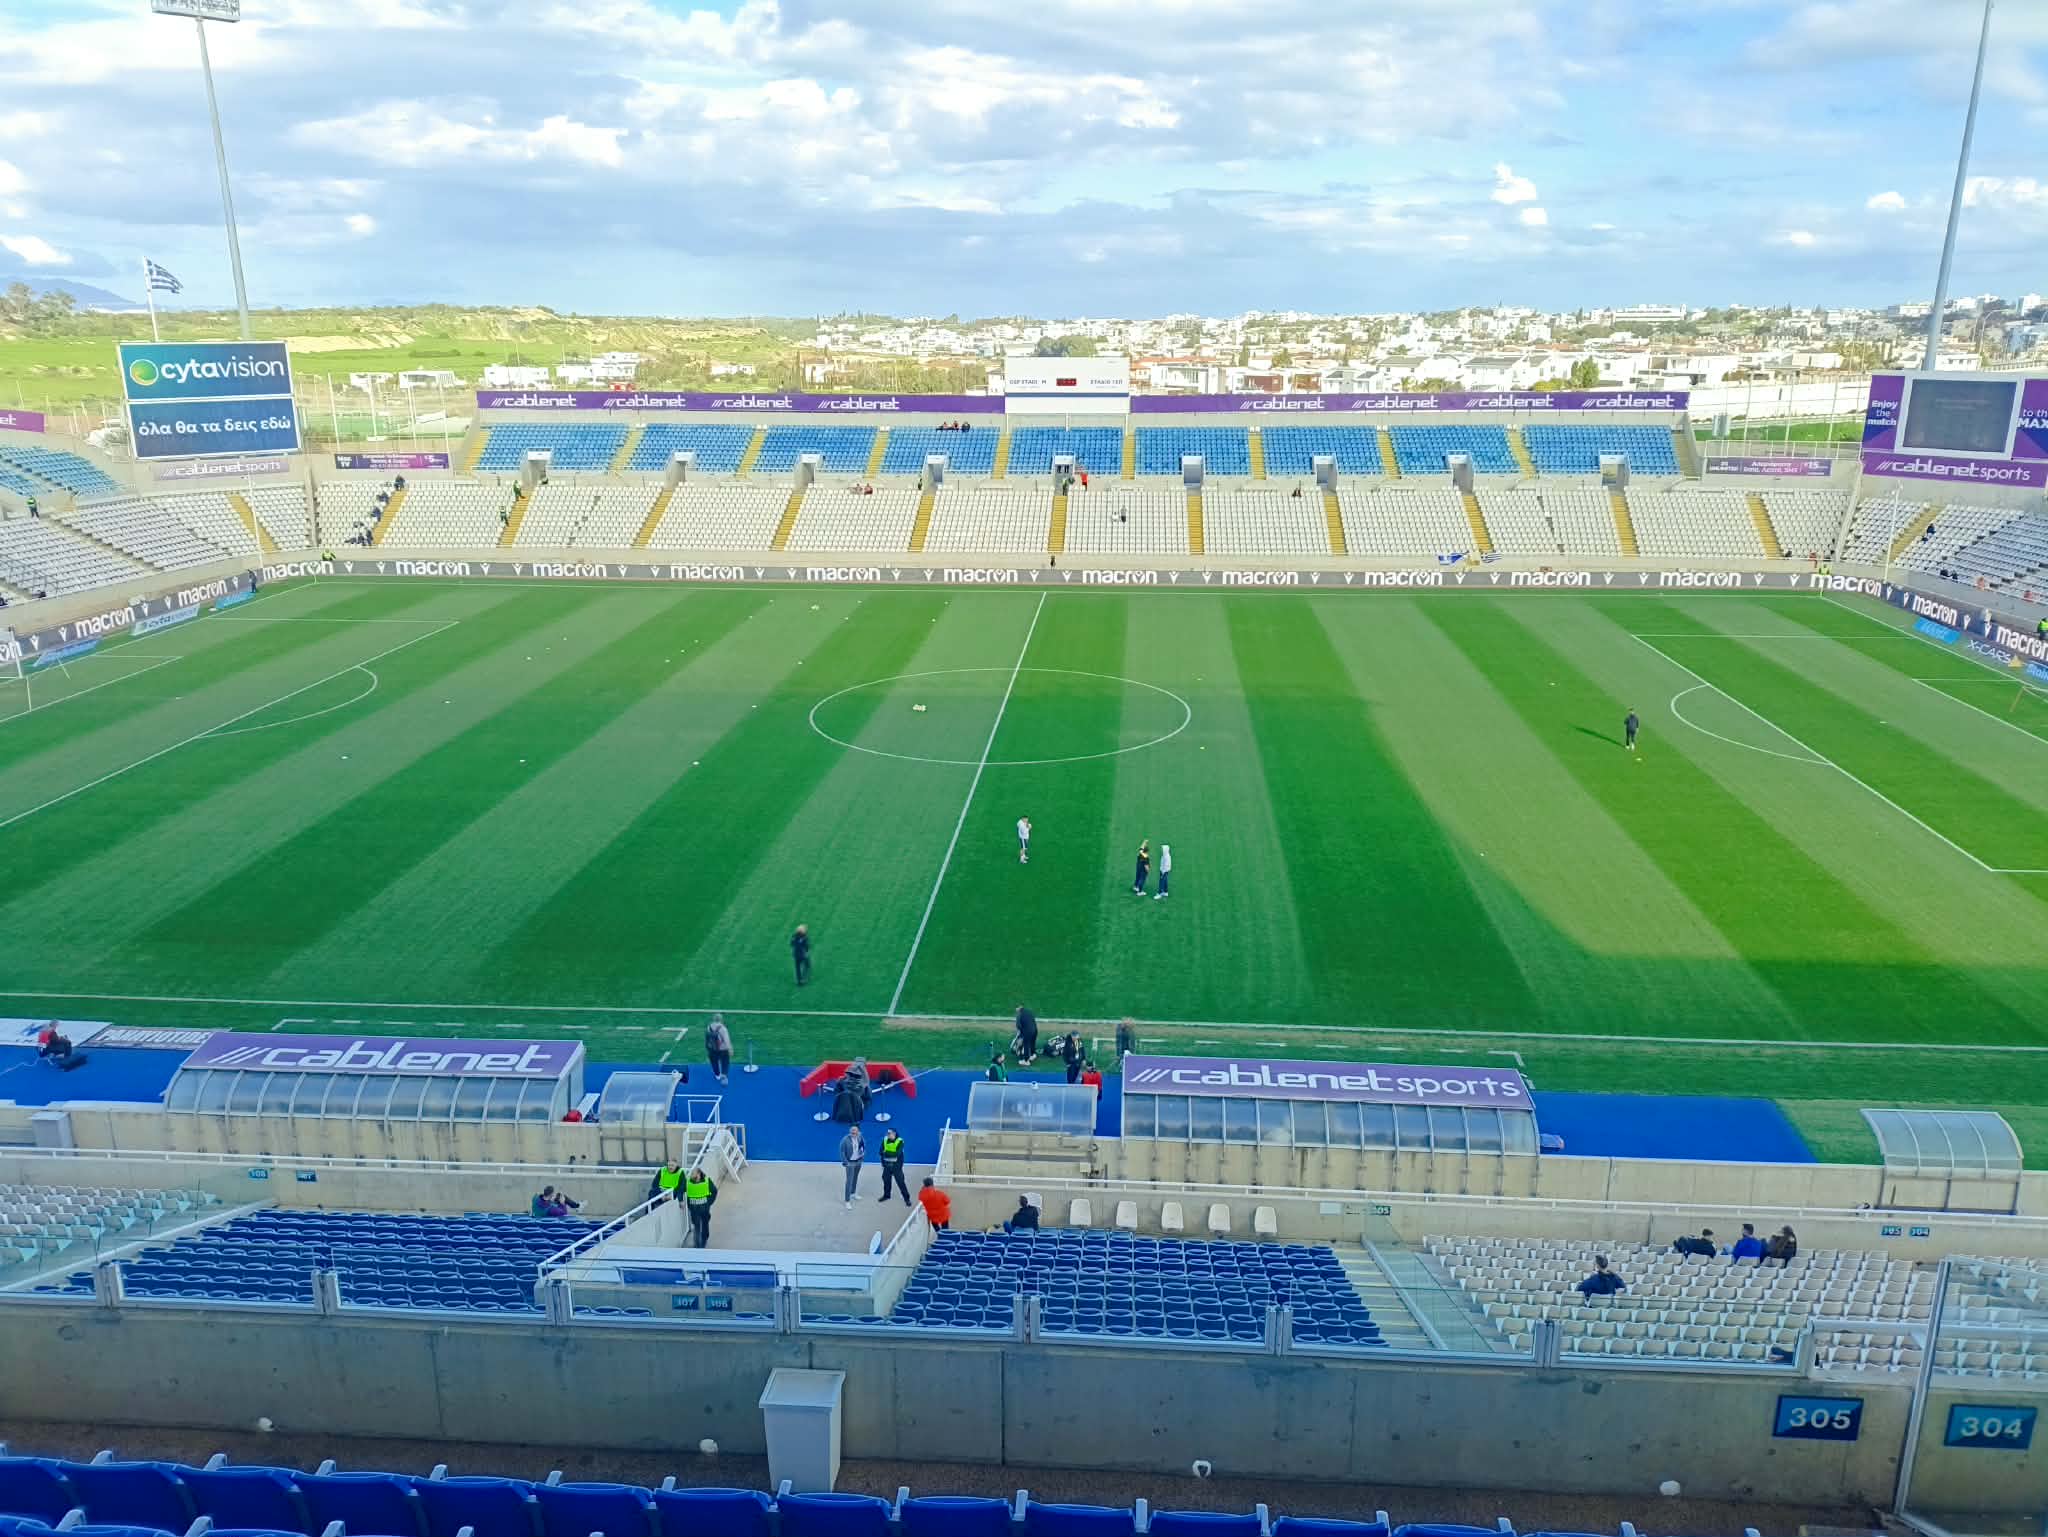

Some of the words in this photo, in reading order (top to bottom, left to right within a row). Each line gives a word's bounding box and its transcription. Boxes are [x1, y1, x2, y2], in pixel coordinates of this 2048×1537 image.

[161, 355, 284, 383] cytavision
[503, 394, 577, 407] cablenet
[614, 394, 687, 408] cablenet
[723, 395, 793, 409] cablenet
[831, 397, 900, 410] cablenet
[1250, 396, 1325, 410] cablenet
[1363, 395, 1438, 409] cablenet
[1477, 394, 1554, 408] cablenet
[1593, 394, 1675, 408] cablenet
[1872, 400, 1898, 410] Enjoy
[1876, 409, 1891, 417] the
[2023, 409, 2034, 417] to
[139, 420, 172, 436] όλα
[175, 421, 198, 434] θα
[201, 423, 221, 433] τα
[224, 419, 258, 432] δεις
[261, 415, 291, 430] εδώ
[1867, 418, 1897, 426] match
[262, 560, 334, 581] macron
[396, 561, 470, 576] macron
[532, 563, 607, 577] macron
[670, 565, 744, 579] macron
[806, 566, 881, 581] macron
[943, 568, 1018, 582] macron
[1082, 569, 1158, 584] macron
[1222, 570, 1299, 584] macron
[1364, 571, 1443, 586] macron
[1510, 571, 1591, 586] macron
[1660, 572, 1742, 587] macron
[178, 579, 228, 607] macron
[1810, 574, 1882, 598] macron
[1912, 595, 1958, 626] macron
[75, 606, 136, 638] macron
[260, 1041, 552, 1073] cablenet
[1789, 1407, 1851, 1430] 305
[1960, 1416, 2023, 1438] 304
